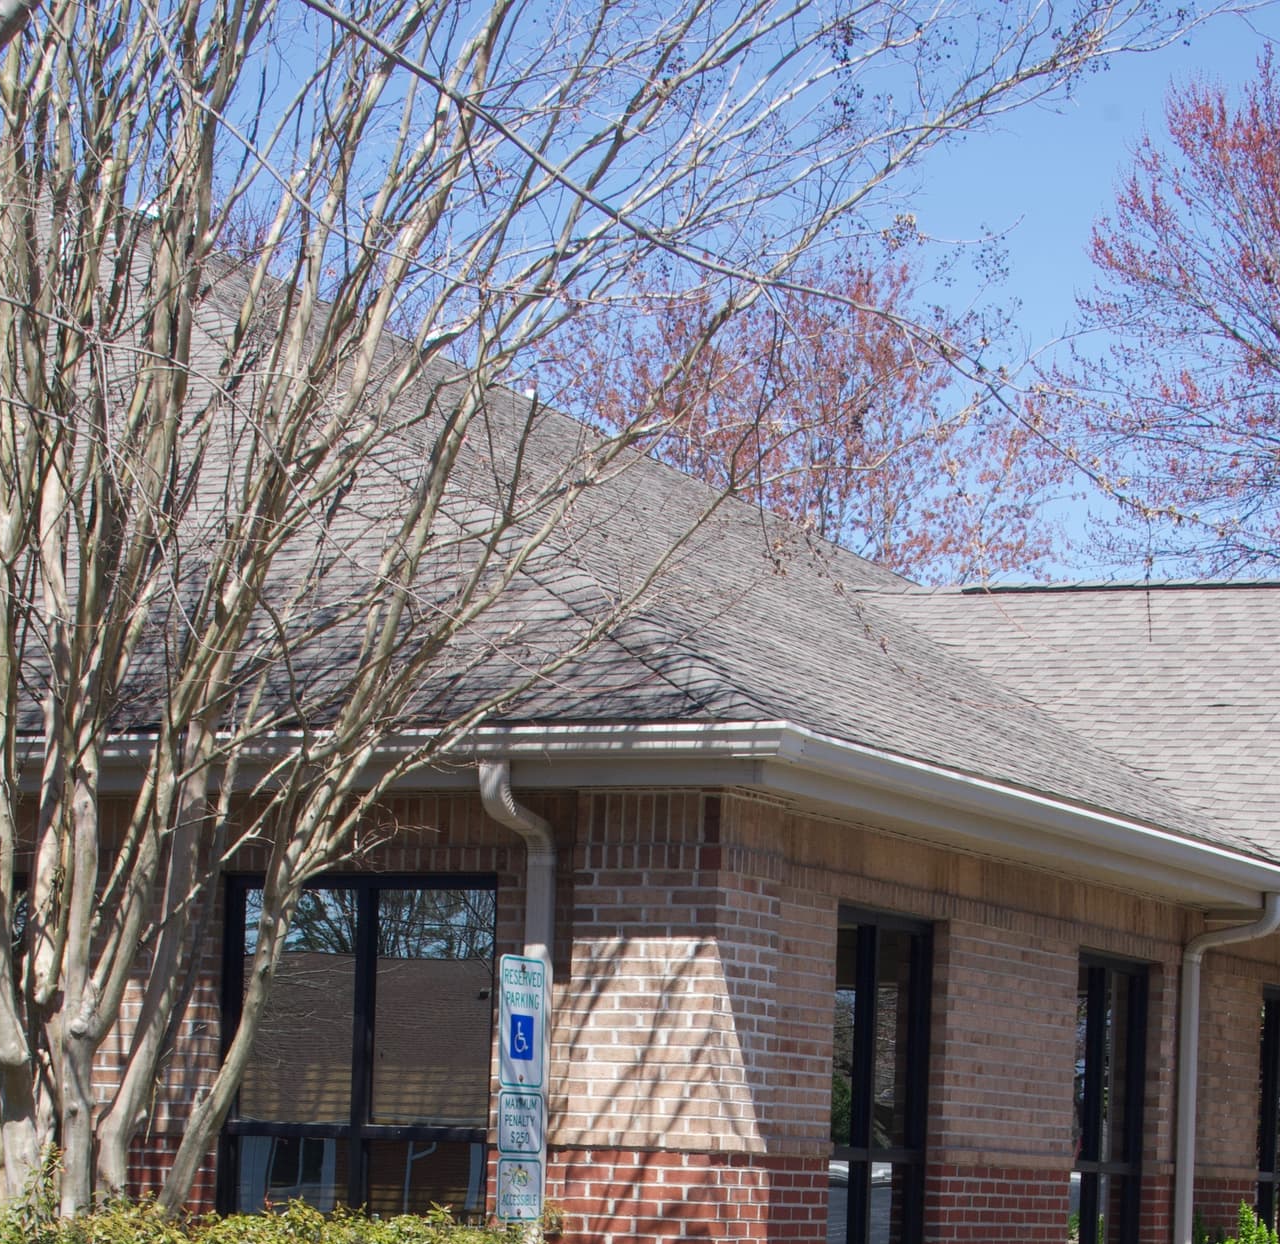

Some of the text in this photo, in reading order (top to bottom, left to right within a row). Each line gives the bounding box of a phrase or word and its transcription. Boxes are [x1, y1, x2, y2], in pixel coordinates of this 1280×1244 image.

[504, 968, 543, 988] RESERVED
[506, 991, 540, 1010] PARKING
[505, 1113, 535, 1127] PENALTY
[510, 1131, 529, 1144] $250
